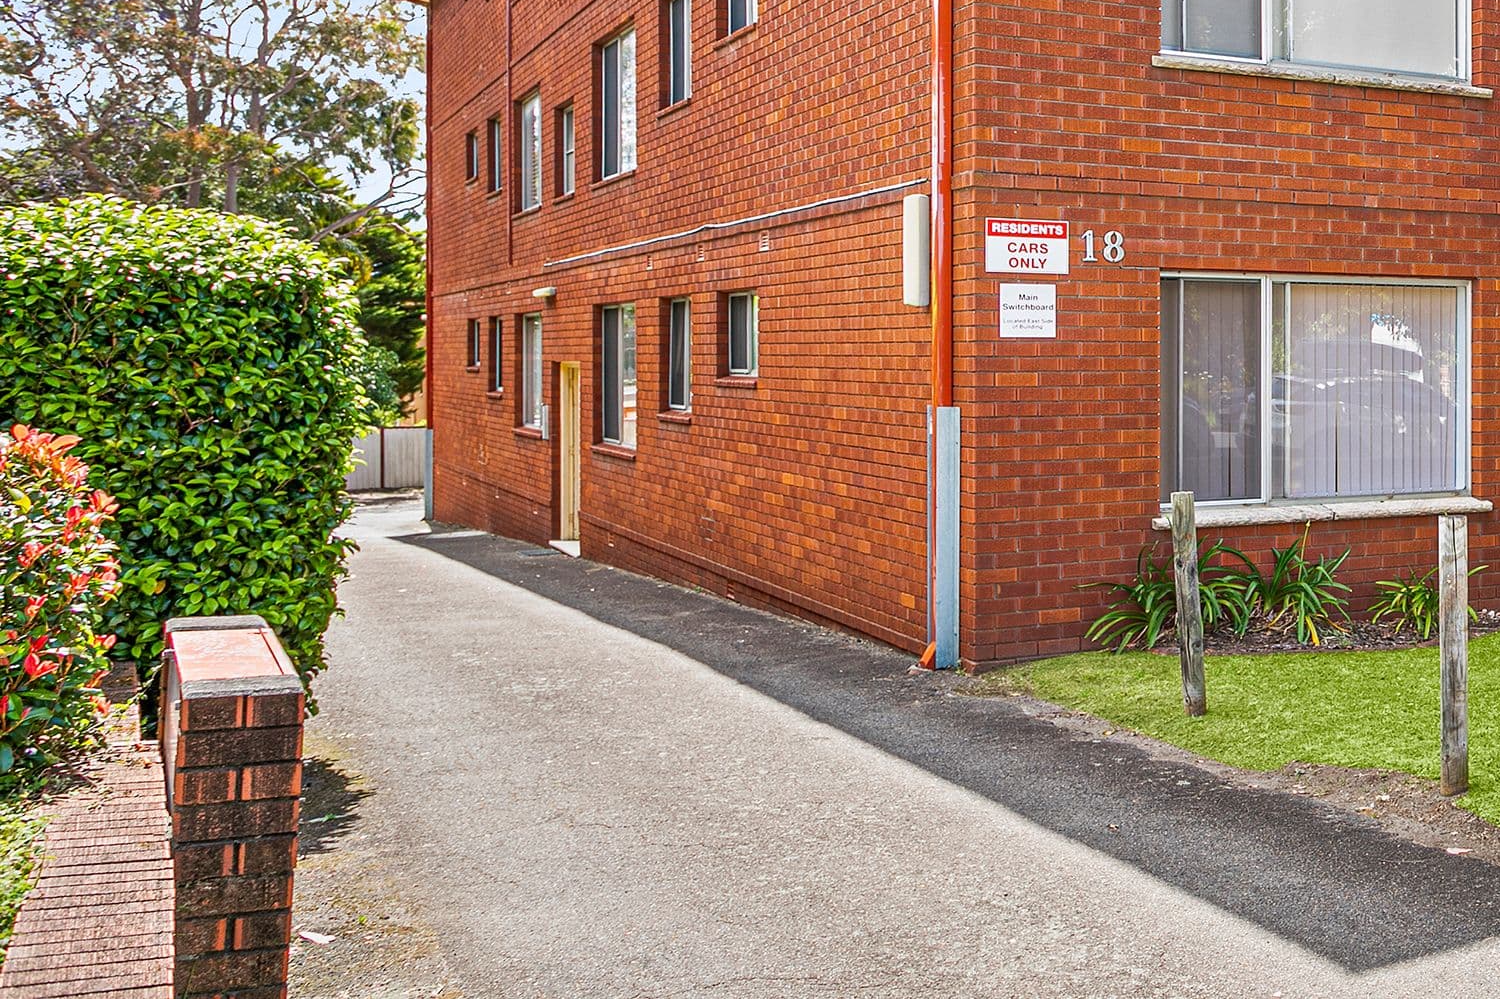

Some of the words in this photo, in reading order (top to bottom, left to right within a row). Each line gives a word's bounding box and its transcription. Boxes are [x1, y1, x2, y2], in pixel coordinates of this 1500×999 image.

[991, 222, 1064, 236] RESIDENTS
[1007, 242, 1049, 254] CARS
[1081, 229, 1125, 263] 18
[1008, 257, 1047, 269] ONLY
[1002, 303, 1054, 311] Switchboard
